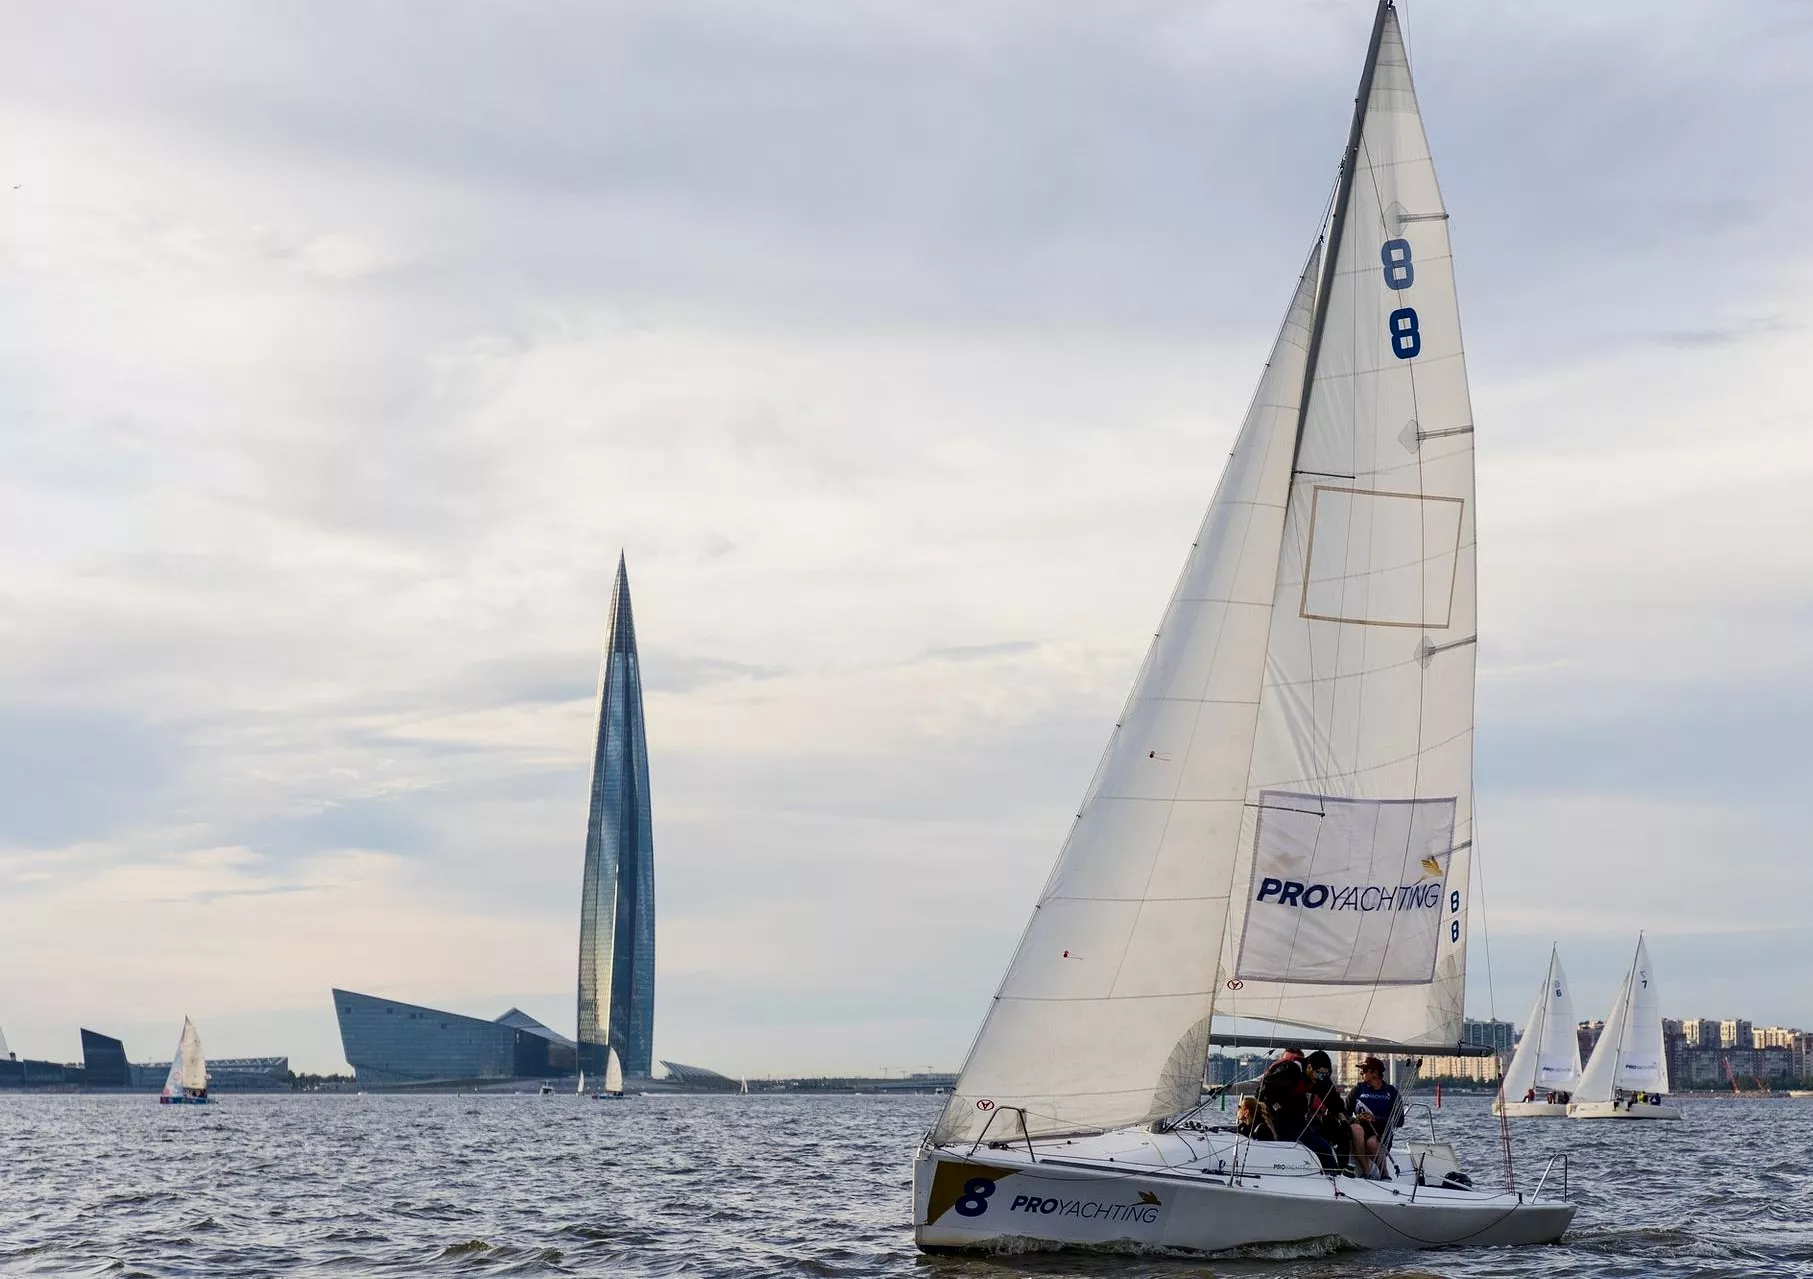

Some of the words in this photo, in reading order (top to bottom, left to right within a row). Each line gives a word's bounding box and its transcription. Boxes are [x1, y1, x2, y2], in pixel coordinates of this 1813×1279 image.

[1381, 238, 1414, 291] 8
[1389, 307, 1421, 360] 8
[1256, 877, 1441, 911] PROYACHTING
[1450, 890, 1459, 913] 8
[1451, 920, 1459, 943] 8
[1641, 980, 1647, 989] 7
[955, 1177, 996, 1217] 8
[1010, 1195, 1160, 1223] PROYACHTING
